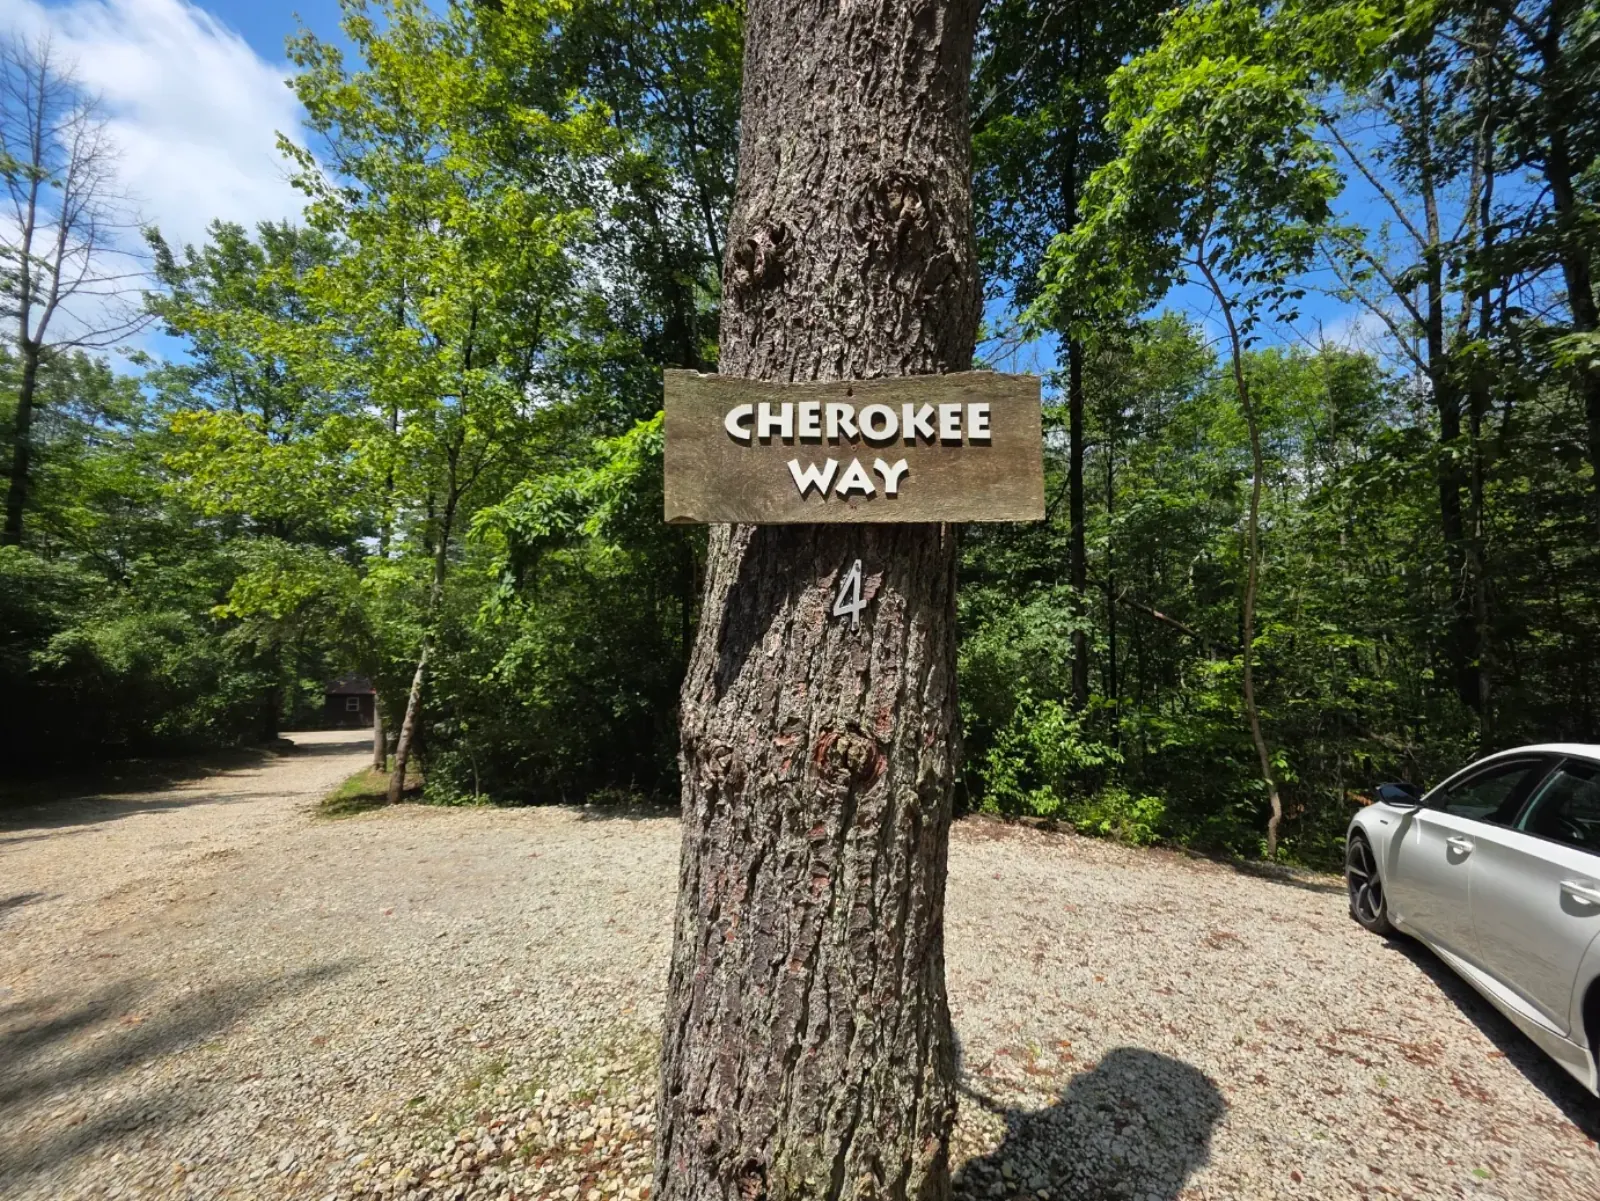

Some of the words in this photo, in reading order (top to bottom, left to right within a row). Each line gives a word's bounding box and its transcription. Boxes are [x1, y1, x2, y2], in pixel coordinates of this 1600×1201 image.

[724, 401, 992, 441] CHEROKEE
[787, 457, 909, 496] WAY
[833, 558, 867, 631] 4
